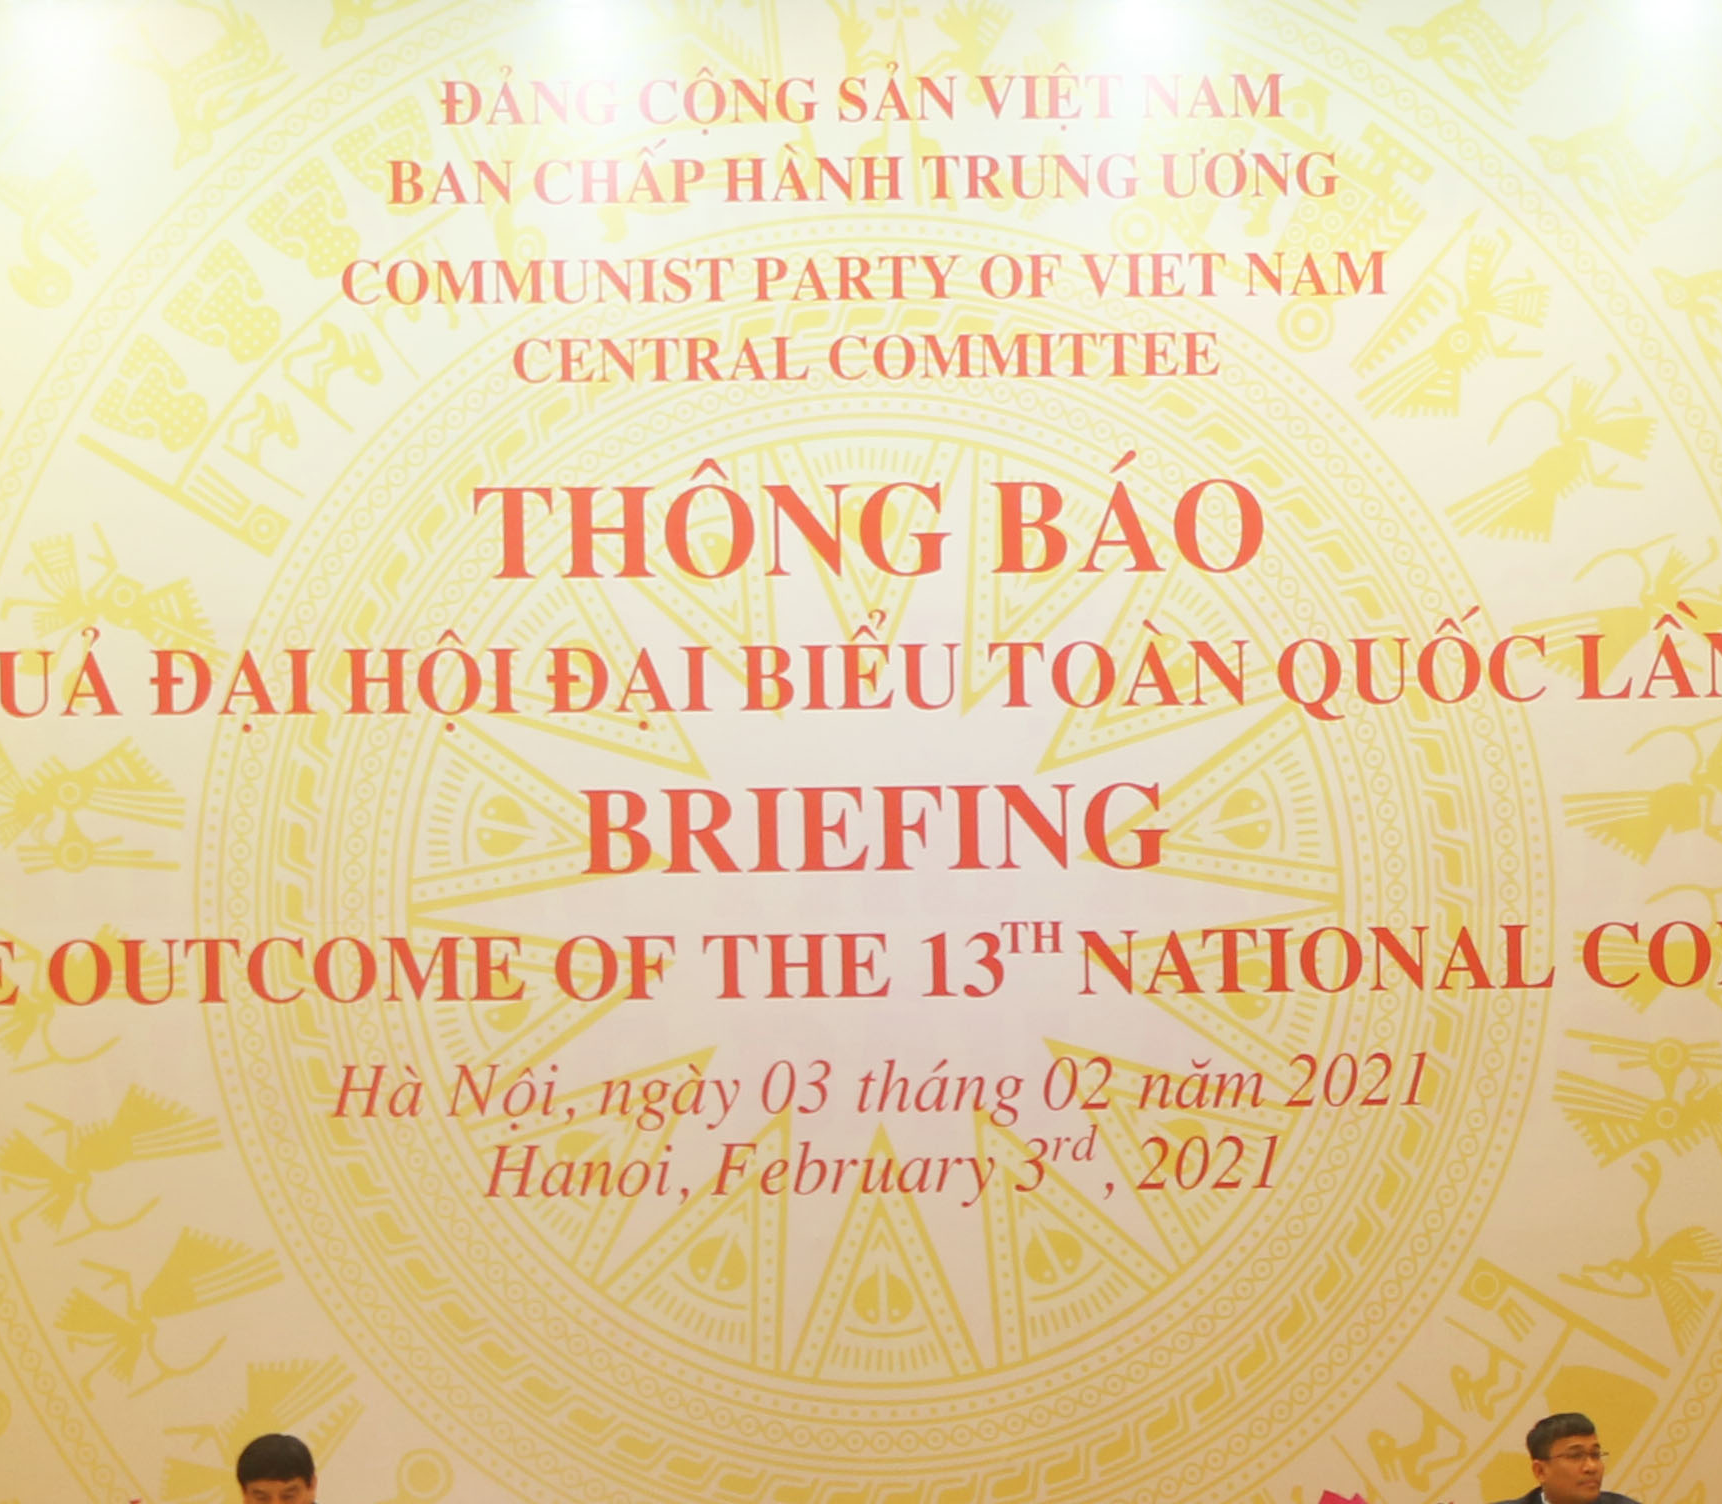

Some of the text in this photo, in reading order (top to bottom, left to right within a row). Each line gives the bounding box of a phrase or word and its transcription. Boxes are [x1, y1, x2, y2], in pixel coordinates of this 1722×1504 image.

[441, 62, 1283, 137] ĐẢNG CỘNG SẢN VIỆT NAM
[389, 136, 1338, 206] BAN CHẤP HÀNH TRUNG ƯƠNG
[341, 250, 1388, 305] COMMUNIST PARTY OF VIET NAM
[513, 331, 1220, 384] CENTRAL COMMITTEE
[473, 450, 1265, 579] THÔNG BÁO
[150, 648, 315, 733] ĐẠI
[344, 628, 518, 732] HỘI
[546, 646, 711, 730] ĐẠI
[742, 610, 960, 711] BIỂU
[988, 619, 1248, 708] TOÀN
[1277, 605, 1548, 721] QUỐC
[581, 782, 1169, 875] BRIEFING
[48, 936, 526, 1006] OUTCOME
[554, 934, 676, 1002] OF
[702, 932, 891, 999] THE
[1078, 924, 1556, 995] NATIONAL
[333, 1051, 1427, 1131] Hà Nội, ngày 03 tháng 02 năm 2021
[485, 1144, 690, 1201] Hanoi,
[707, 1139, 995, 1208] February
[1137, 1134, 1279, 1190] 2021
